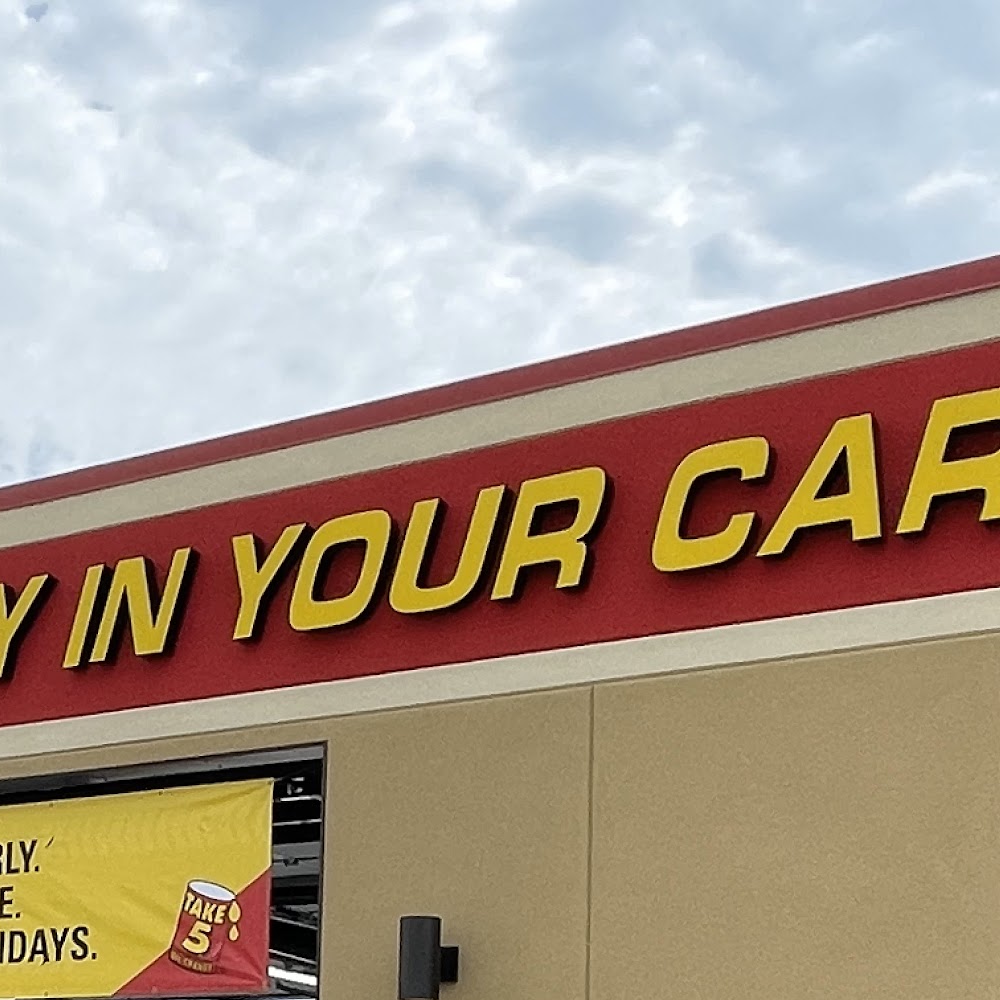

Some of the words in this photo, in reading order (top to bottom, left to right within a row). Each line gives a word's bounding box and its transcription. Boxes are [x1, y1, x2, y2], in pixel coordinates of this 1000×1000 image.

[63, 547, 190, 668] IN
[231, 466, 606, 640] YOUR
[651, 387, 1000, 573] CAR
[183, 892, 227, 924] TAKE
[181, 920, 212, 953] 5
